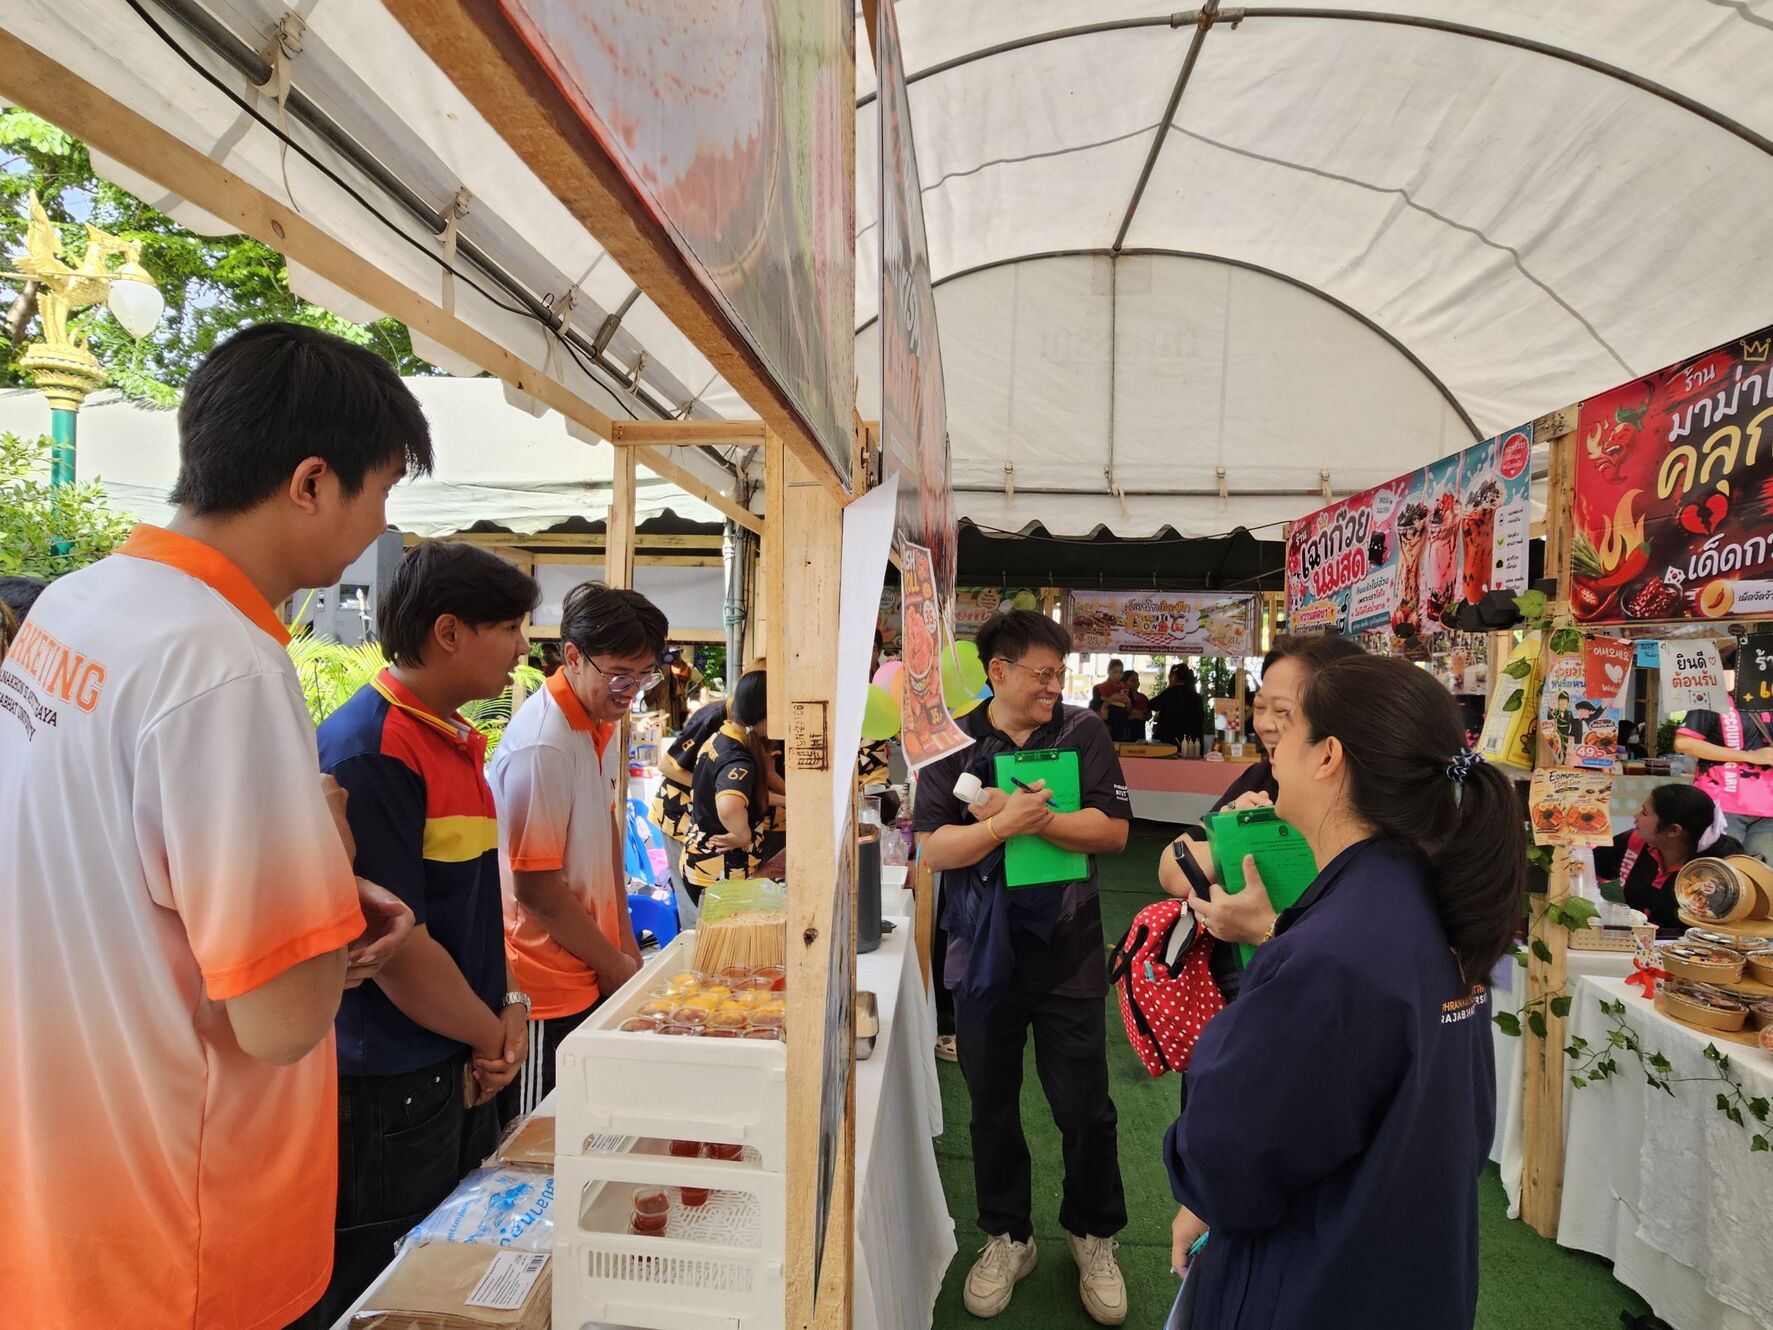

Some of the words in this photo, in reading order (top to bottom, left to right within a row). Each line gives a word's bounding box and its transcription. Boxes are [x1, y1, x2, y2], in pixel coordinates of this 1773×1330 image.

[1685, 363, 1716, 392] ร้าน
[1301, 506, 1371, 580] เฉาก๊วย
[1313, 546, 1366, 597] นมสด
[1677, 651, 1708, 670] ยินดี
[1672, 670, 1718, 689] ต้อนรับ
[727, 767, 749, 781] 67
[1723, 770, 1738, 793] ARU
